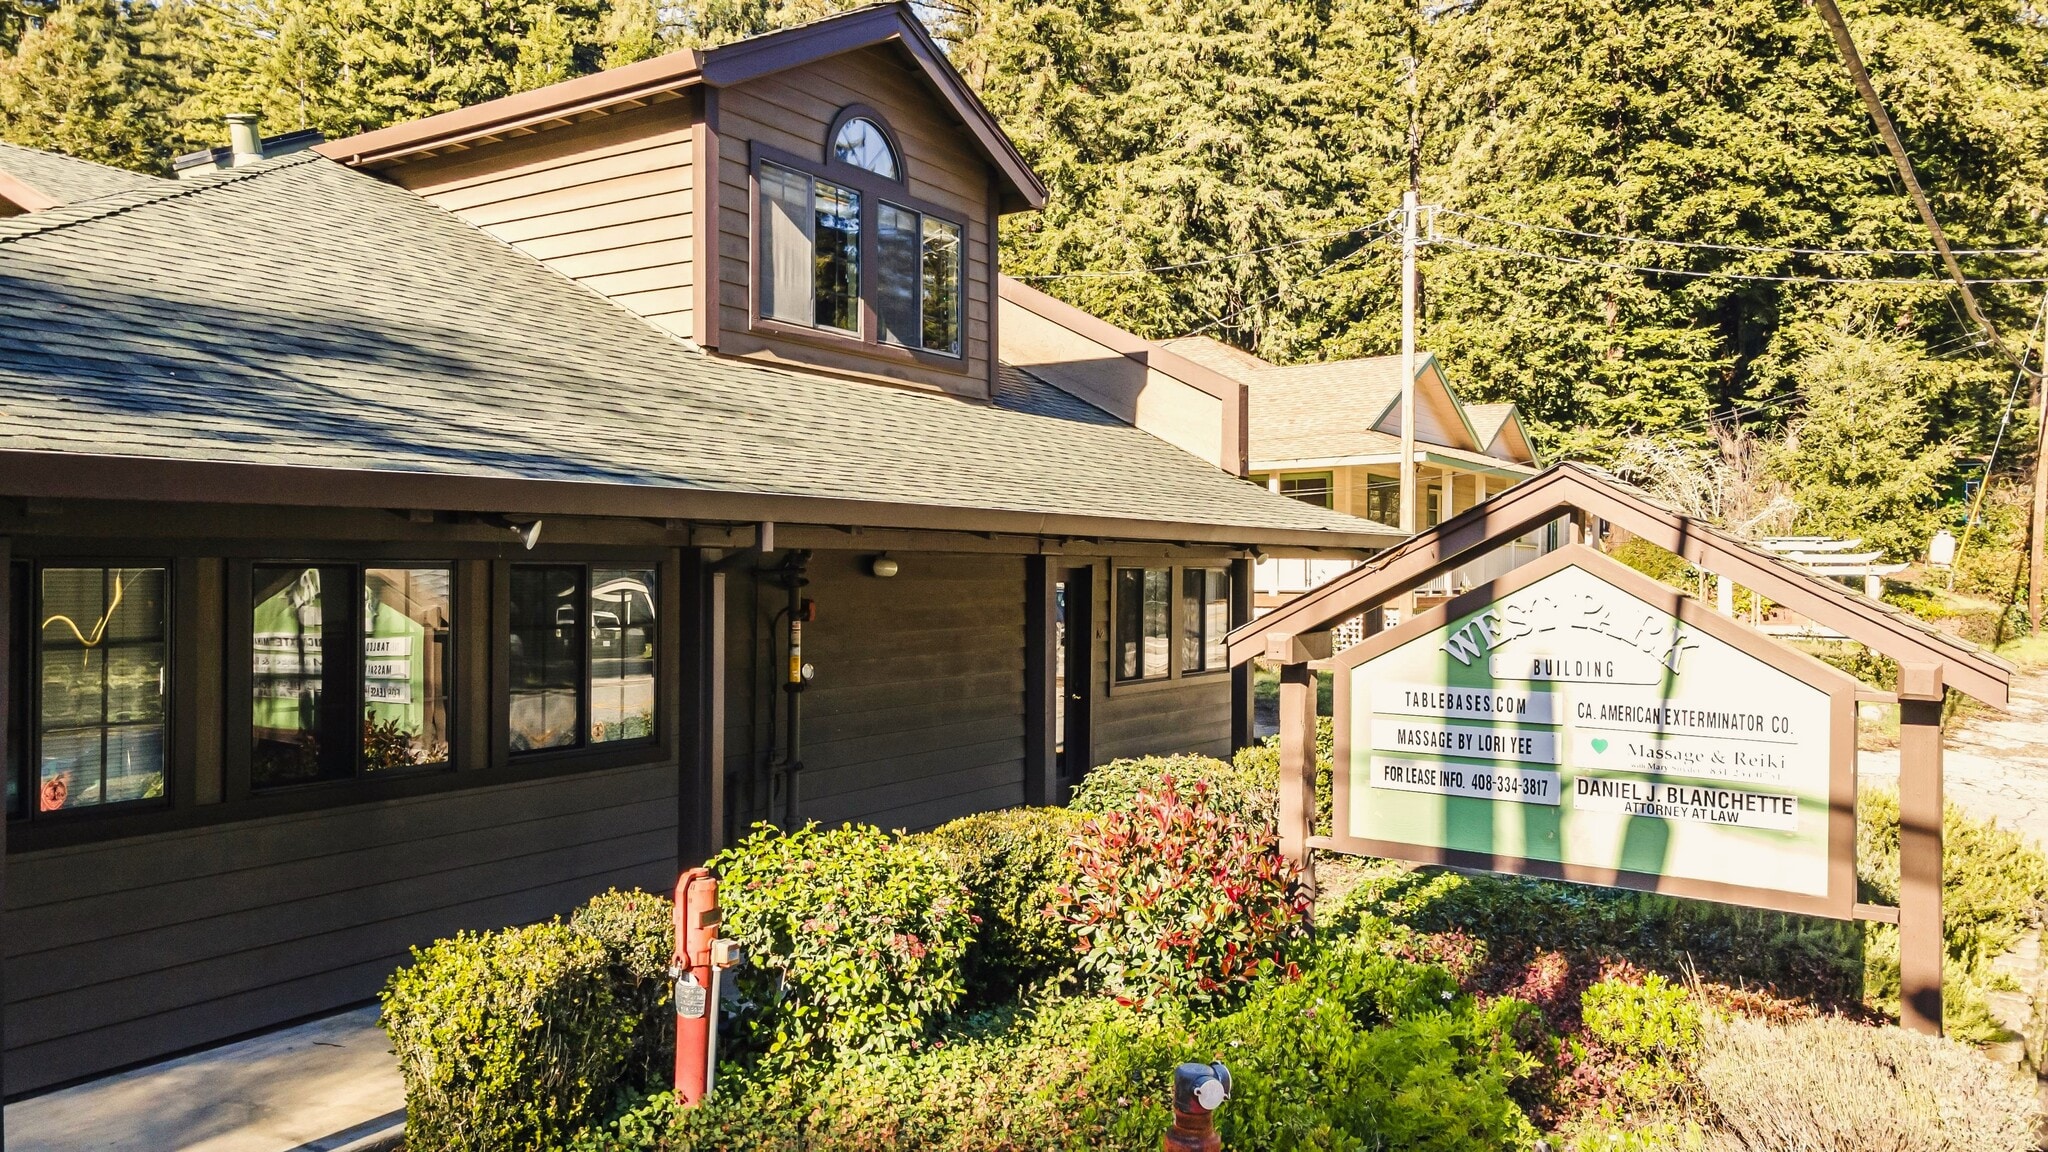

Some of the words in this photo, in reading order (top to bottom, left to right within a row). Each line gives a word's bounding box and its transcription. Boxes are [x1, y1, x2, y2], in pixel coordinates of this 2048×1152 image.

[1439, 597, 1557, 666] WEST
[1533, 658, 1614, 678] BUILDING
[1405, 691, 1526, 714] TABLEBASES.COM
[1577, 702, 1597, 720] CA.
[1600, 704, 1660, 725] AMERICAN
[1664, 708, 1764, 732] EXTERMINATOR
[1771, 716, 1794, 735] CO.
[1397, 729, 1453, 749] MASSAGE
[1458, 733, 1473, 750] BY
[1478, 735, 1505, 753] LORI
[1510, 737, 1532, 755] YEE
[1628, 743, 1705, 765] Massage
[1710, 751, 1726, 764] &
[1734, 751, 1786, 769] Reiki
[1647, 762, 1669, 772] Mary
[1384, 765, 1403, 783] FOR
[1406, 767, 1436, 786] LEASE
[1439, 770, 1465, 789] INFO.
[1471, 773, 1548, 797] 408-334-3817
[1577, 778, 1642, 801] DANIEL
[1646, 785, 1661, 803] J.
[1667, 786, 1793, 816] BLANCHETTE
[1624, 801, 1688, 818] ATTORNEY
[1692, 807, 1706, 820] AT
[1710, 809, 1739, 824] LAW
